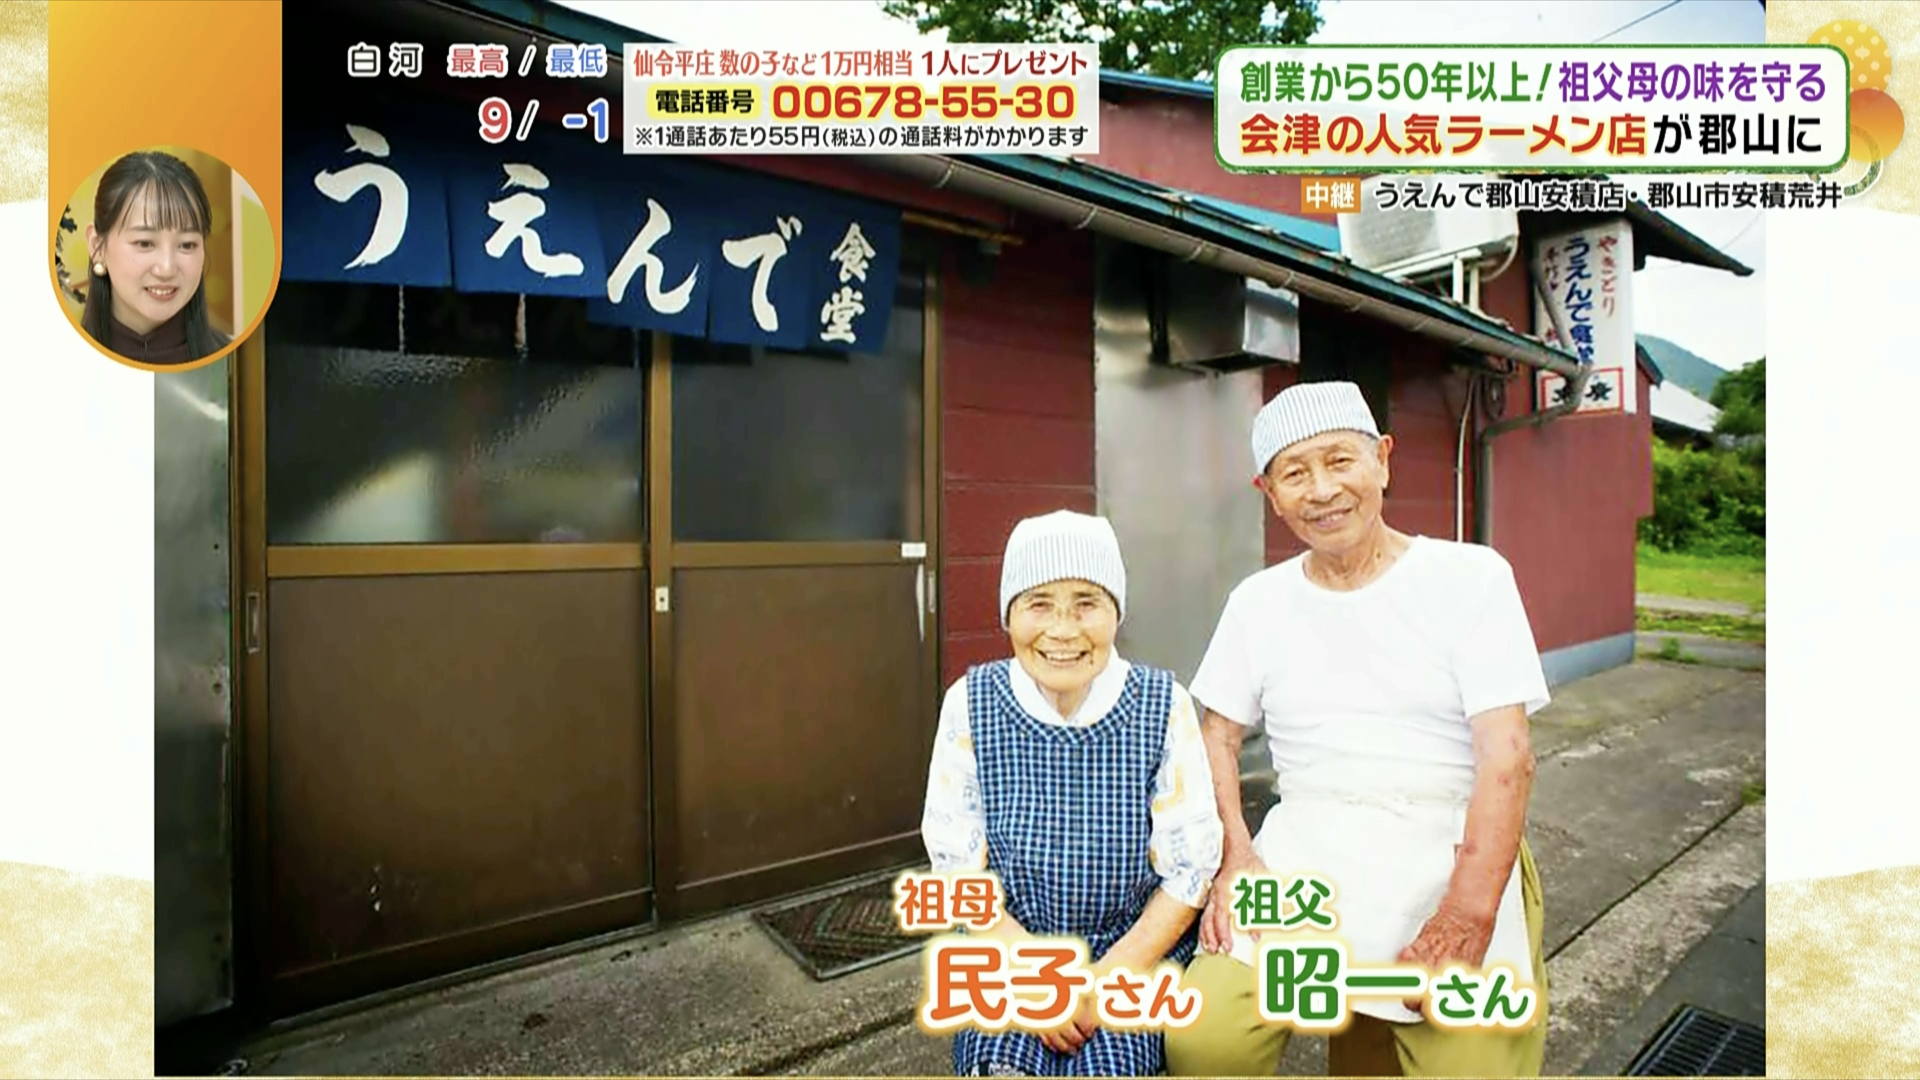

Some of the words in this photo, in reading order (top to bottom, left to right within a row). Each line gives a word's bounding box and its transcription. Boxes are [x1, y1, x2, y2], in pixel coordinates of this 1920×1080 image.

[314, 123, 803, 333] うえんで
[820, 222, 877, 344] 食堂
